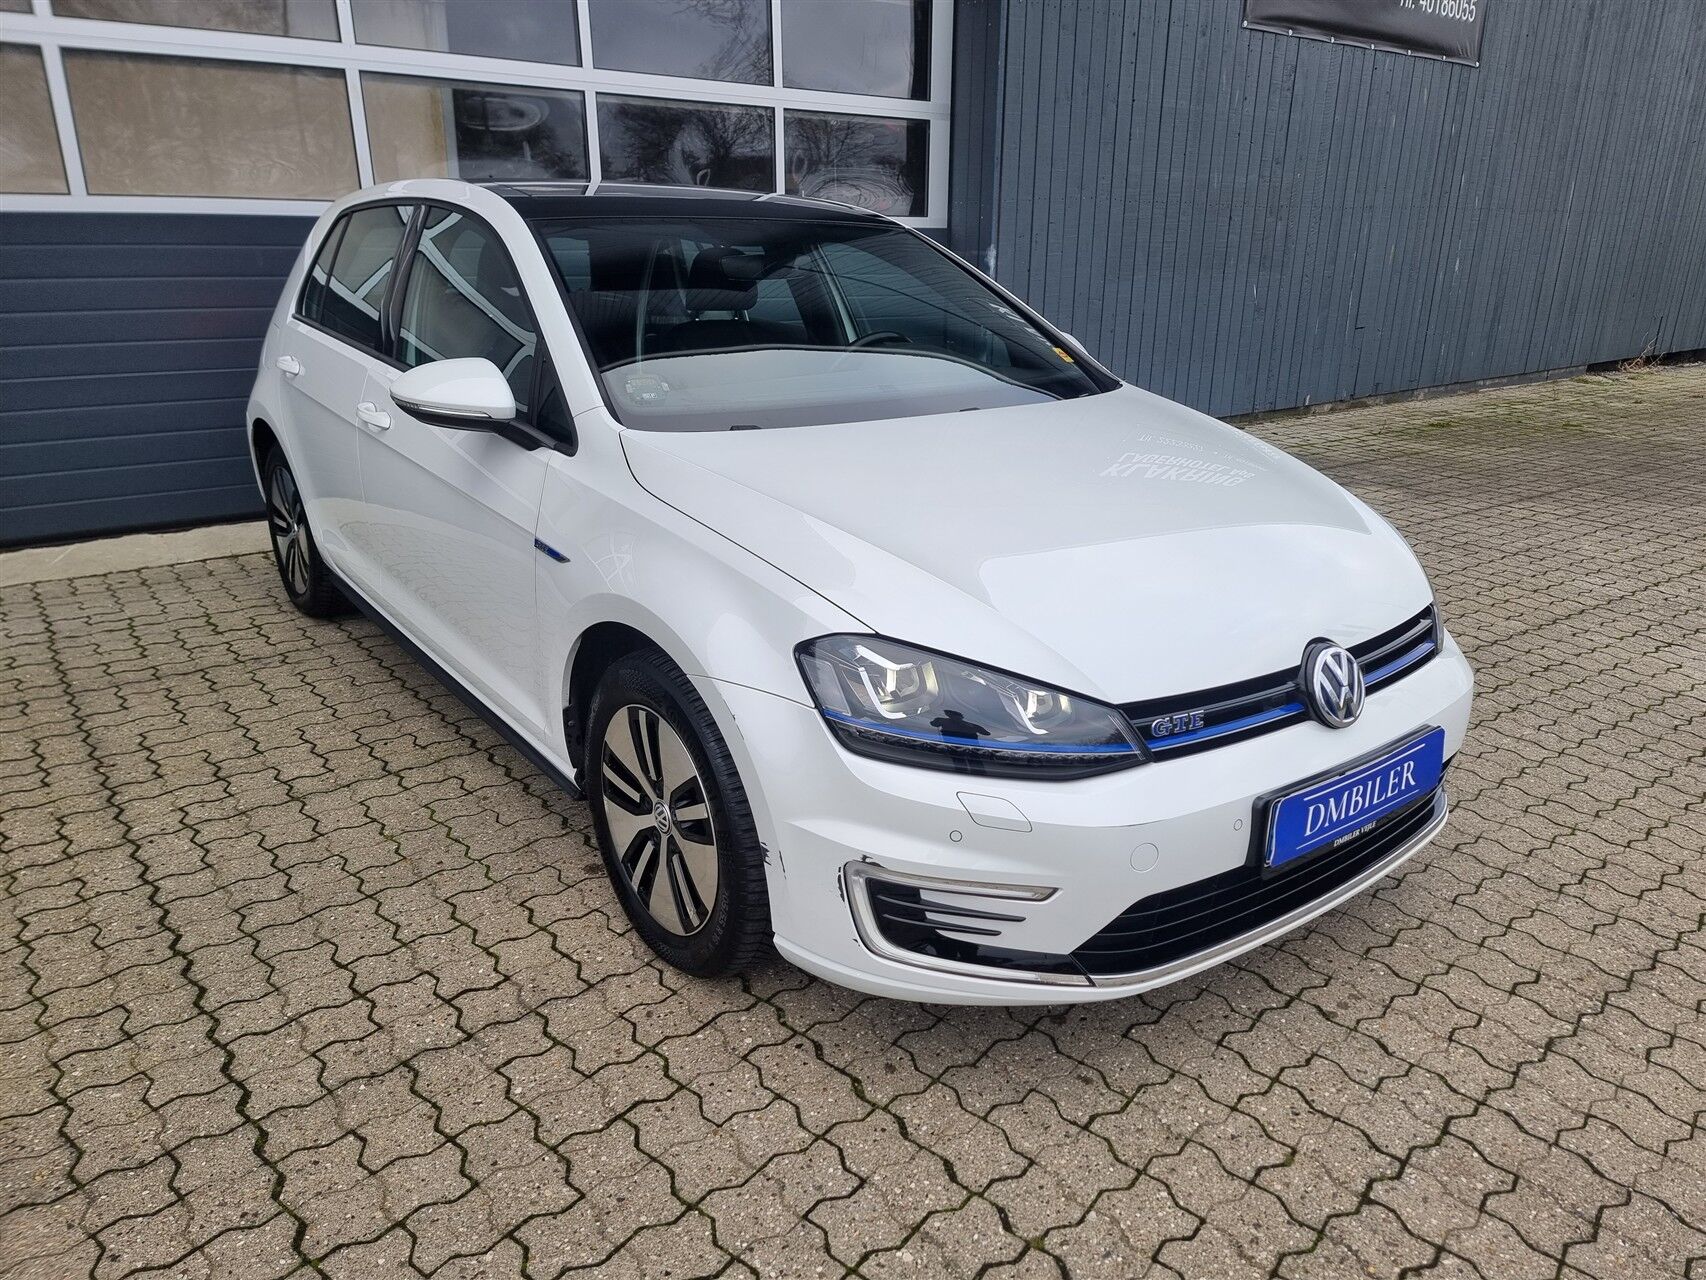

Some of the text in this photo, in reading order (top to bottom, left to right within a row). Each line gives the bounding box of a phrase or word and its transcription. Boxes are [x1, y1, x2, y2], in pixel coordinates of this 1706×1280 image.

[1151, 709, 1204, 738] GTE
[1303, 760, 1416, 838] DMBILER
[1333, 828, 1360, 847] DMBILER
